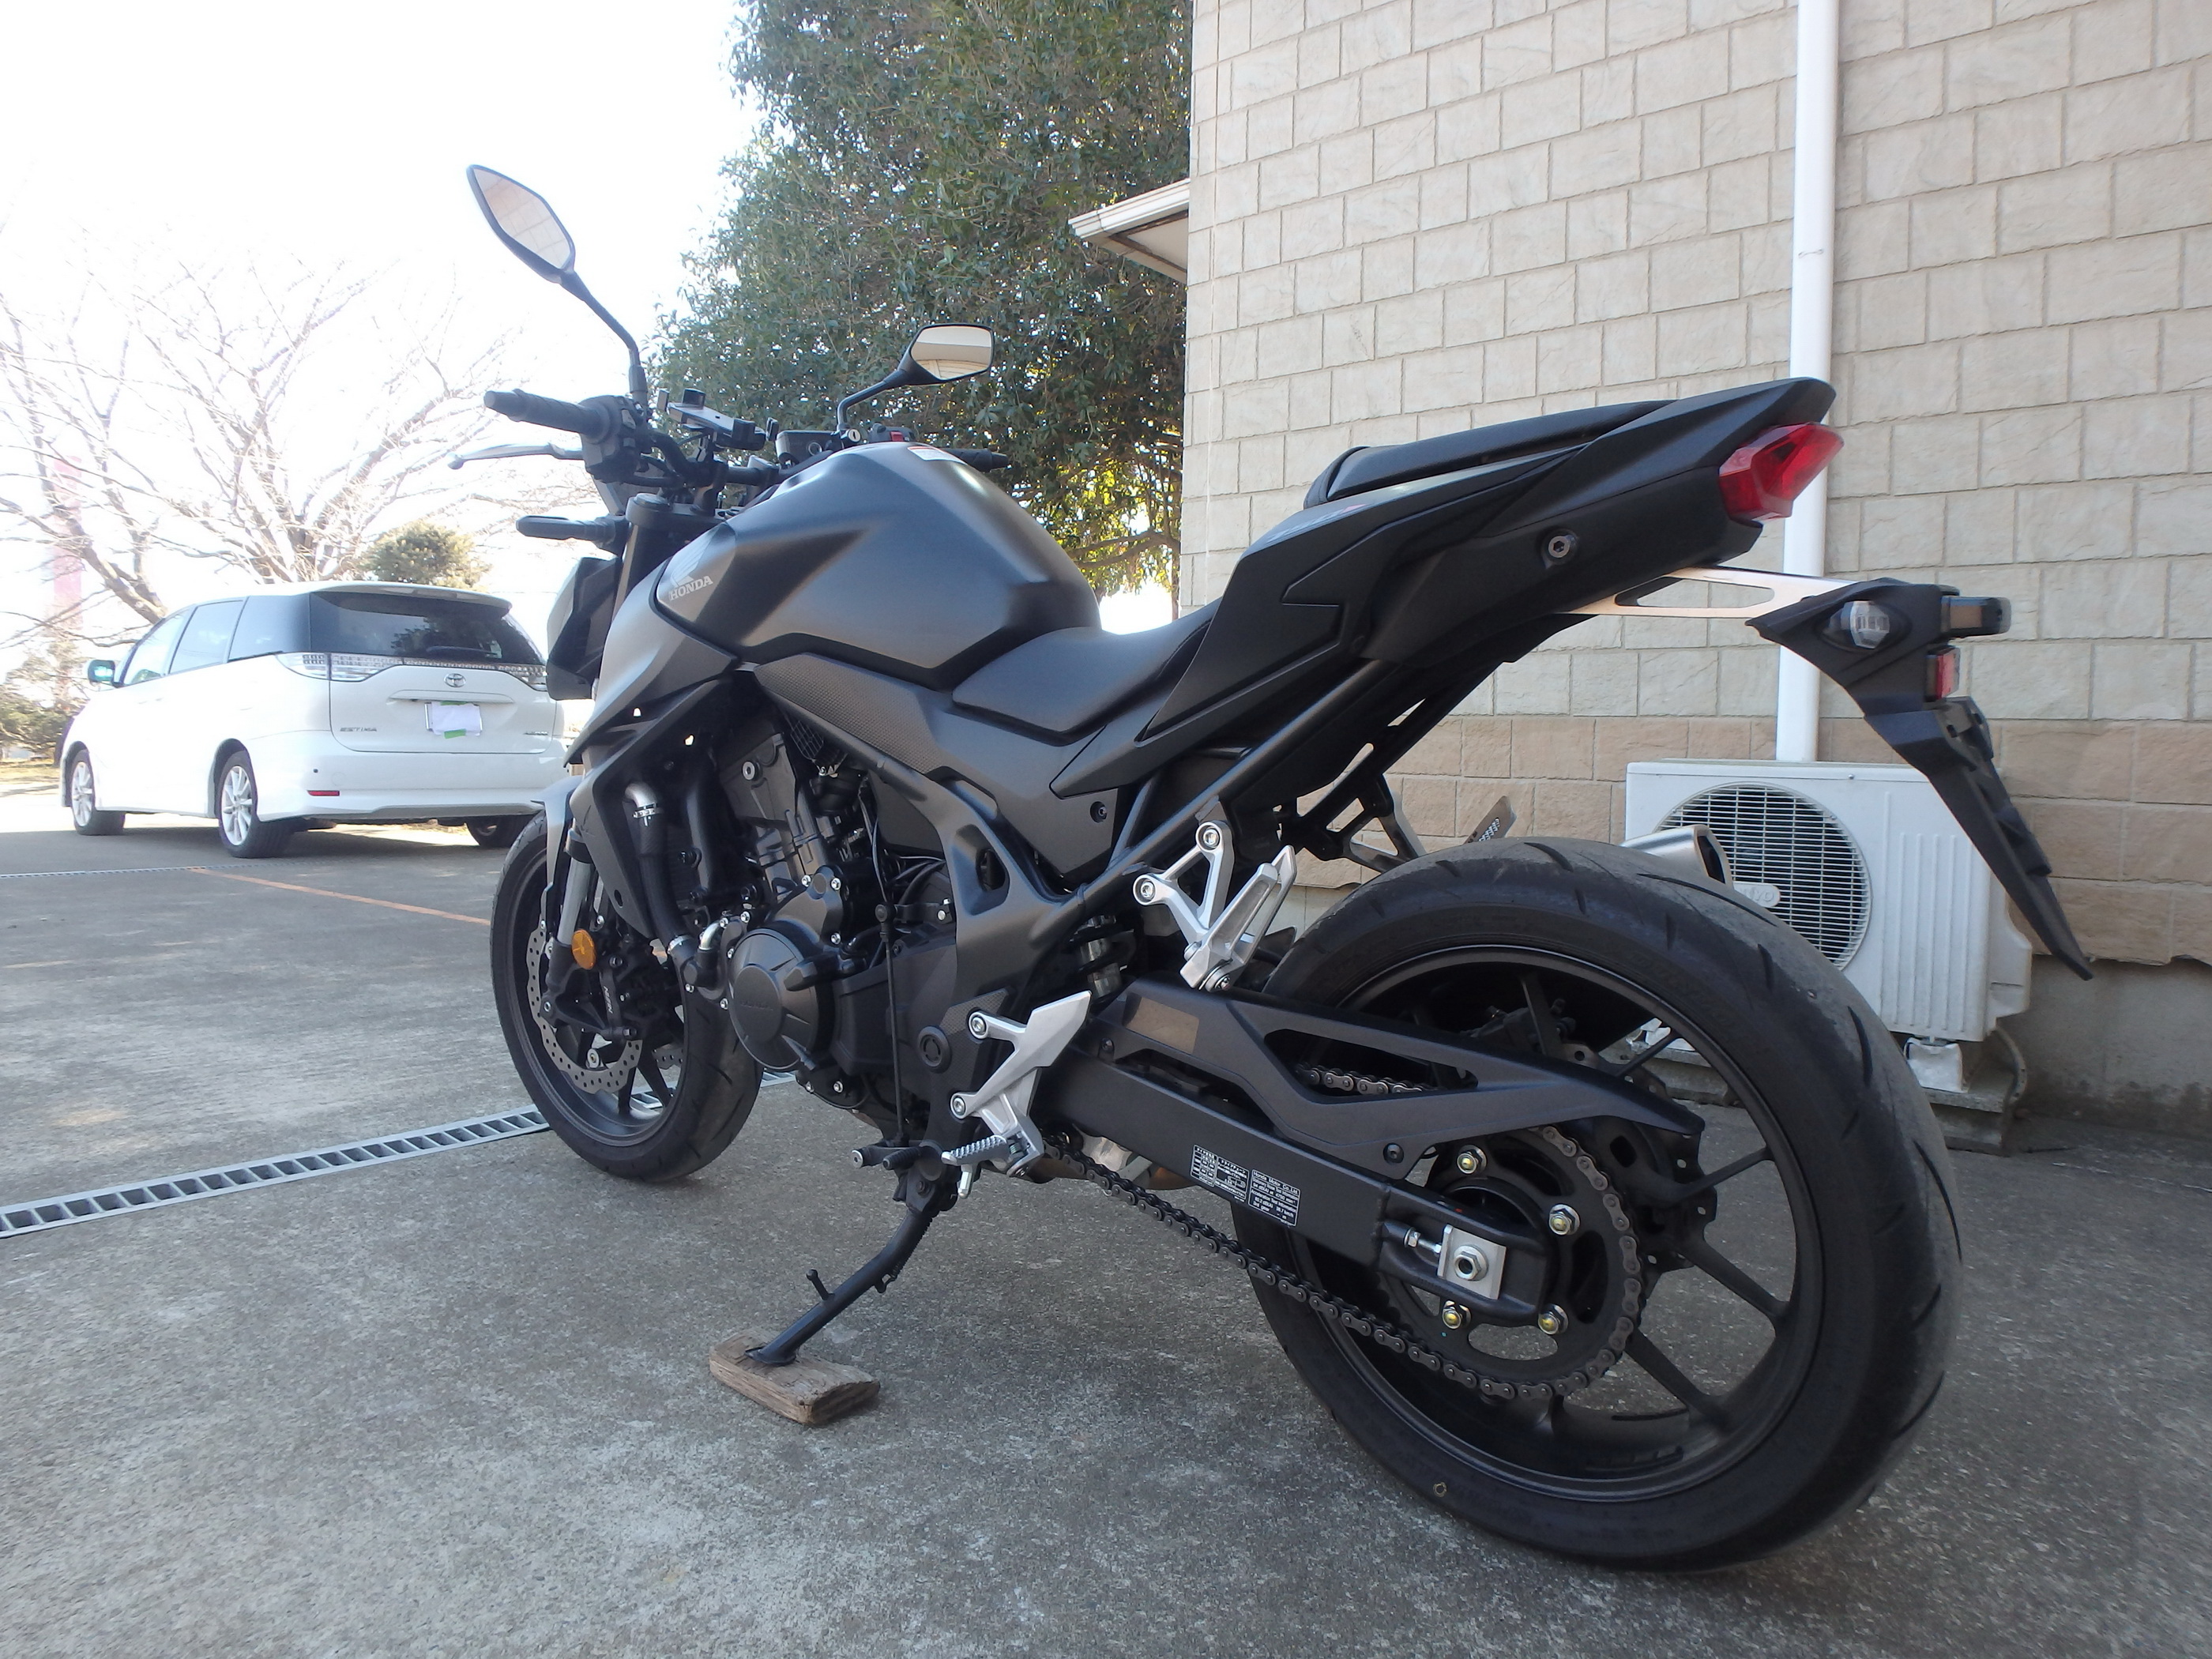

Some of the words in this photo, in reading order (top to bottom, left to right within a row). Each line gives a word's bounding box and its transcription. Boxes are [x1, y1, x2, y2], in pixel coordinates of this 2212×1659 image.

[668, 575, 713, 601] HONDA
[1253, 1171, 1267, 1181] Honda
[1269, 1178, 1281, 1187] Motor
